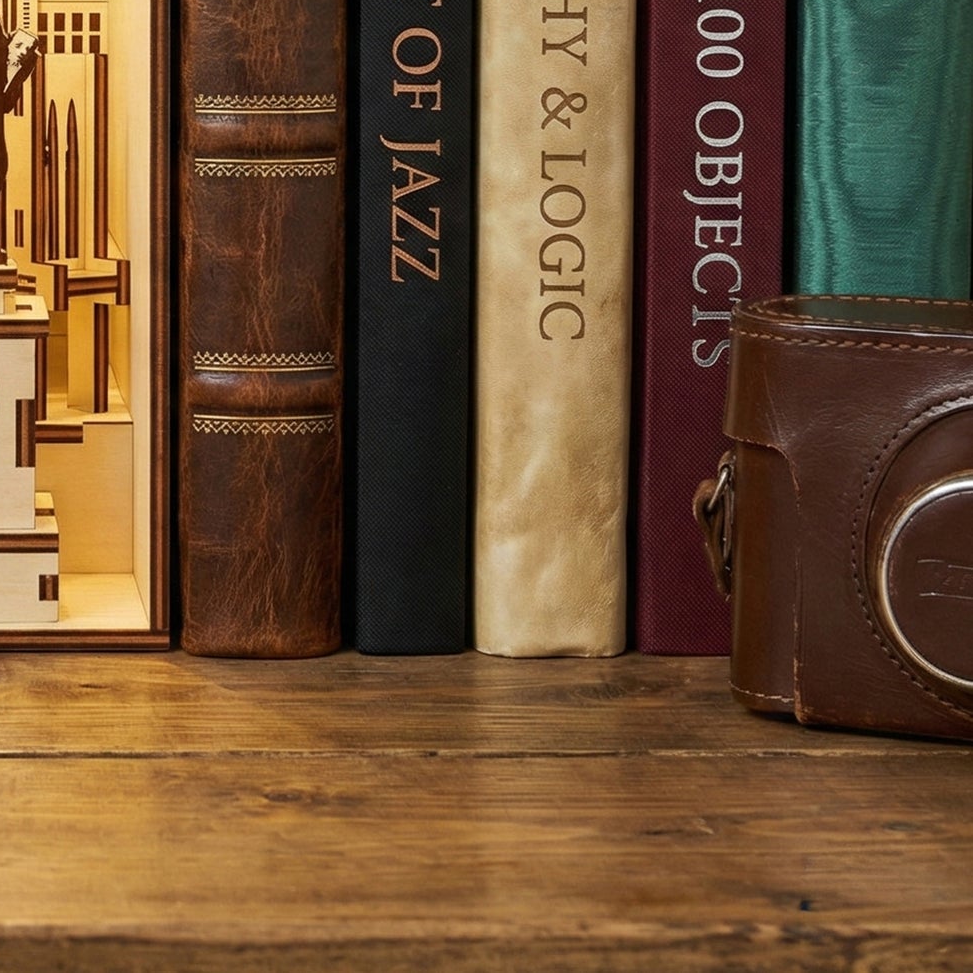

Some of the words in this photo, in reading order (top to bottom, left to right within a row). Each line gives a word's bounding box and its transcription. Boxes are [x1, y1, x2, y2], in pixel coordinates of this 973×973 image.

[391, 27, 443, 112] OF
[540, 87, 588, 130] &
[379, 134, 443, 283] JAZZ
[538, 149, 587, 342] LOGIC
[683, 101, 743, 368] OBJECTS
